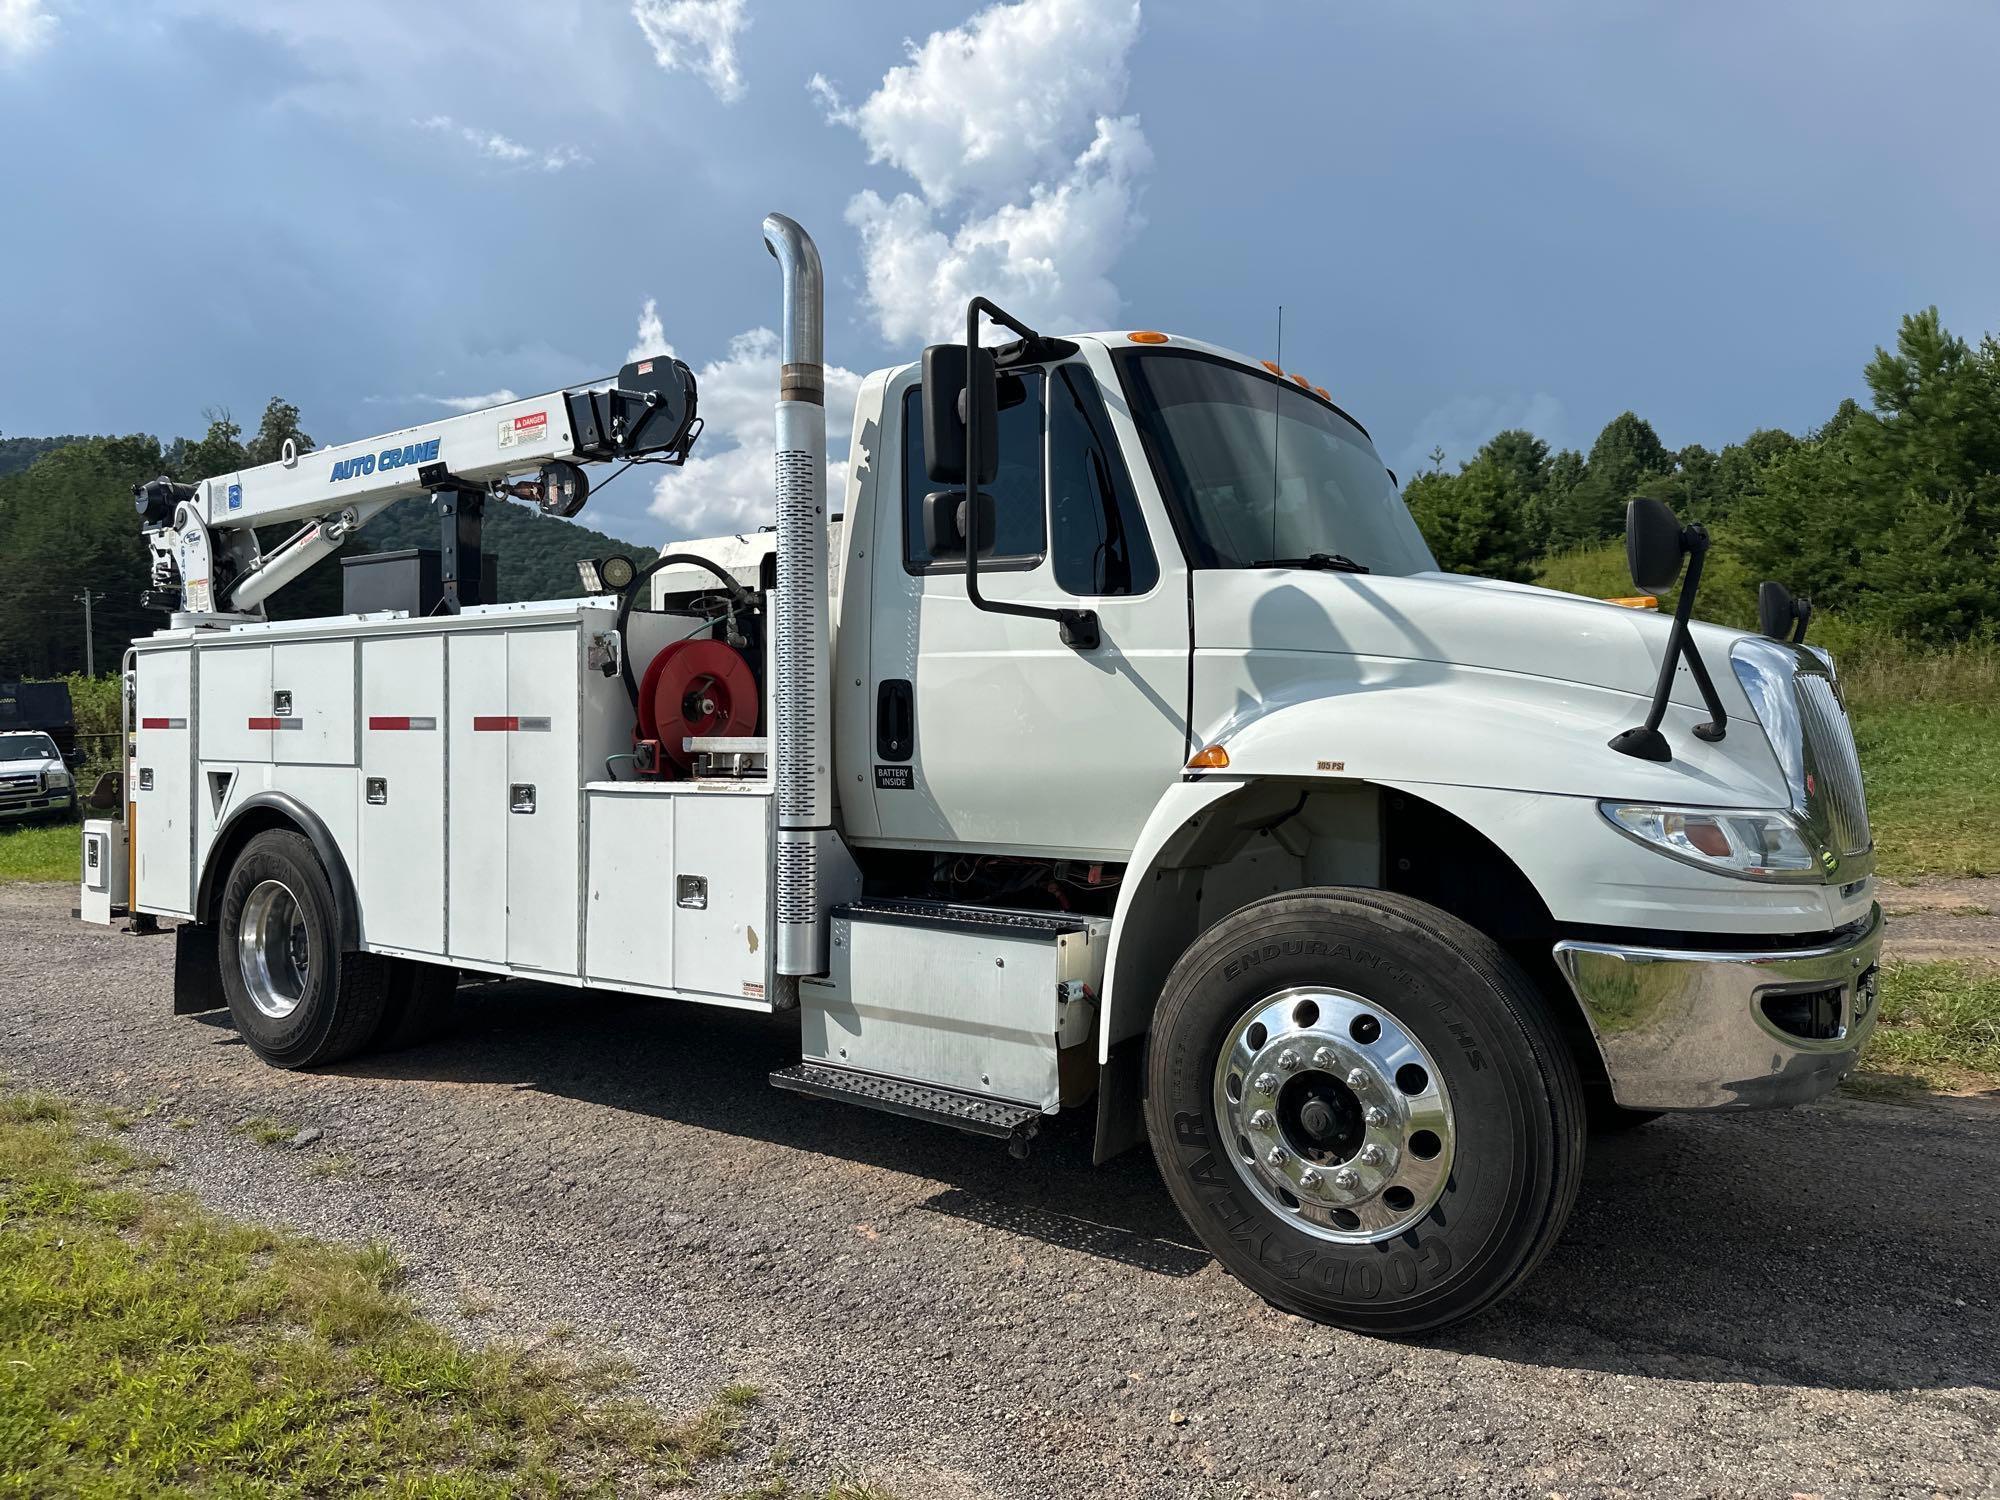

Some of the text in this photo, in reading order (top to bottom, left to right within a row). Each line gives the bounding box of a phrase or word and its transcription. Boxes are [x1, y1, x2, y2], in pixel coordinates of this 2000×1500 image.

[522, 414, 545, 427] DANGER
[329, 438, 440, 483] AUTO CRANE
[1317, 761, 1344, 771] 105 PSI
[878, 768, 909, 777] BATTERY
[882, 778, 906, 786] INSIDE
[1173, 1110, 1453, 1300] GOODYEAR
